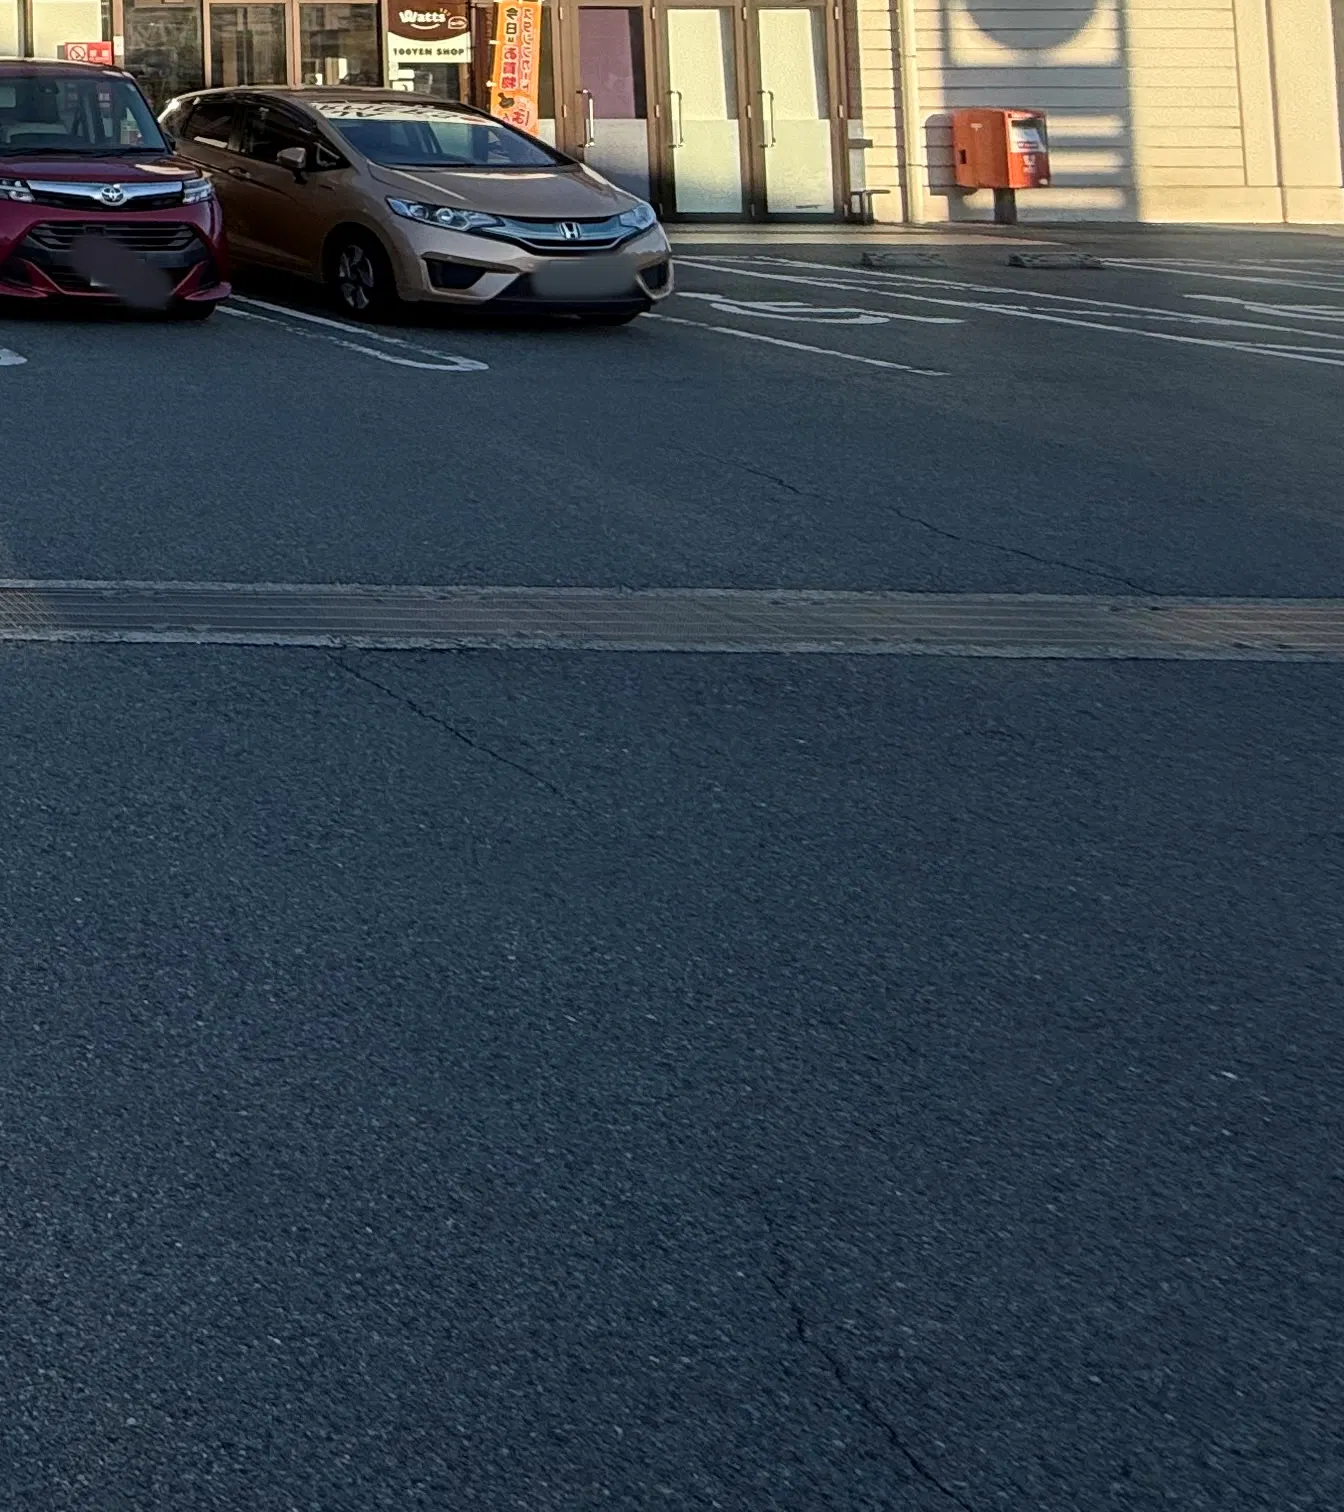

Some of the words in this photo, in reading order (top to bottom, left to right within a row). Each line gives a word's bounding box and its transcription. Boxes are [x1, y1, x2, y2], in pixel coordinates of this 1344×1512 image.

[398, 9, 447, 24] Watts
[393, 47, 433, 56] 100YEN
[436, 47, 465, 56] SHOP
